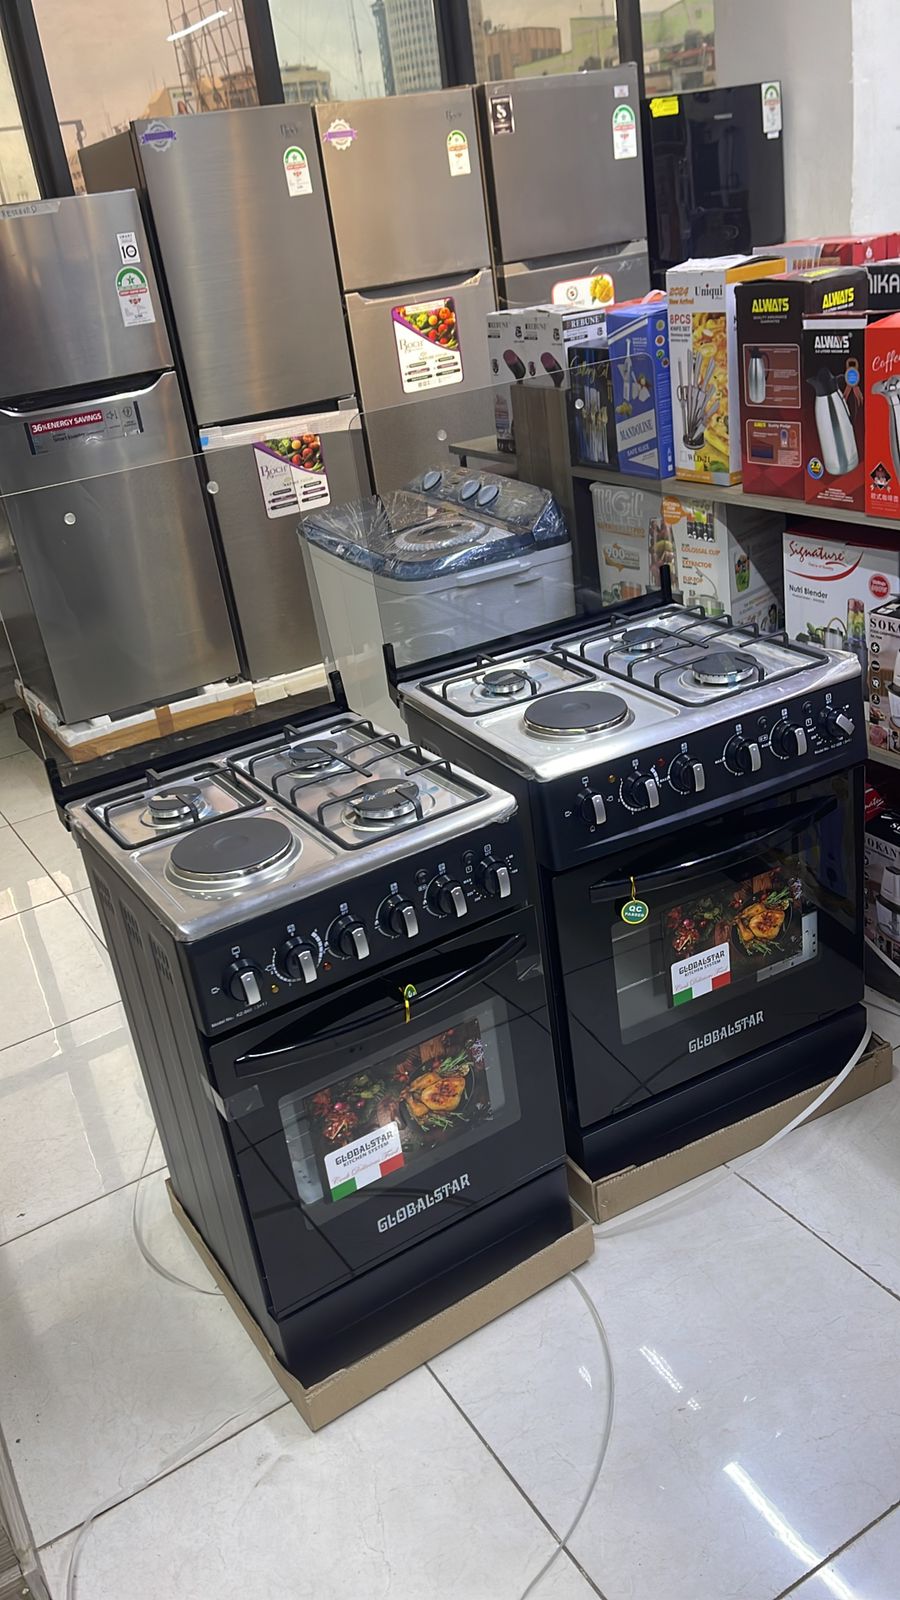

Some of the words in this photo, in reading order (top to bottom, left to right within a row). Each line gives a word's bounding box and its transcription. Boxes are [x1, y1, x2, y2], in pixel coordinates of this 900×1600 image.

[121, 244, 138, 259] 10
[751, 297, 789, 313] ALWAYS
[822, 287, 855, 309] ALWAYS
[814, 335, 850, 349] ALWAYS
[47, 418, 73, 430] ENERGY
[74, 412, 102, 425] SAVINGS
[620, 420, 654, 440] MANDOLINE
[789, 540, 845, 563] Signature
[789, 584, 803, 594] Nutri
[804, 587, 828, 599] Blender
[870, 617, 900, 633] SOK
[628, 905, 643, 913] QC
[678, 950, 725, 975] GLOBALSTAR
[684, 966, 704, 977] KITCHEN
[704, 959, 721, 969] SYSTEM
[688, 1010, 765, 1053] GLOBALSTAR
[335, 1130, 394, 1166] GLOBALSTAR
[343, 1152, 367, 1168] KITCHEN
[368, 1141, 389, 1155] SYSTEM
[376, 1173, 471, 1233] GLOBALSTAR
